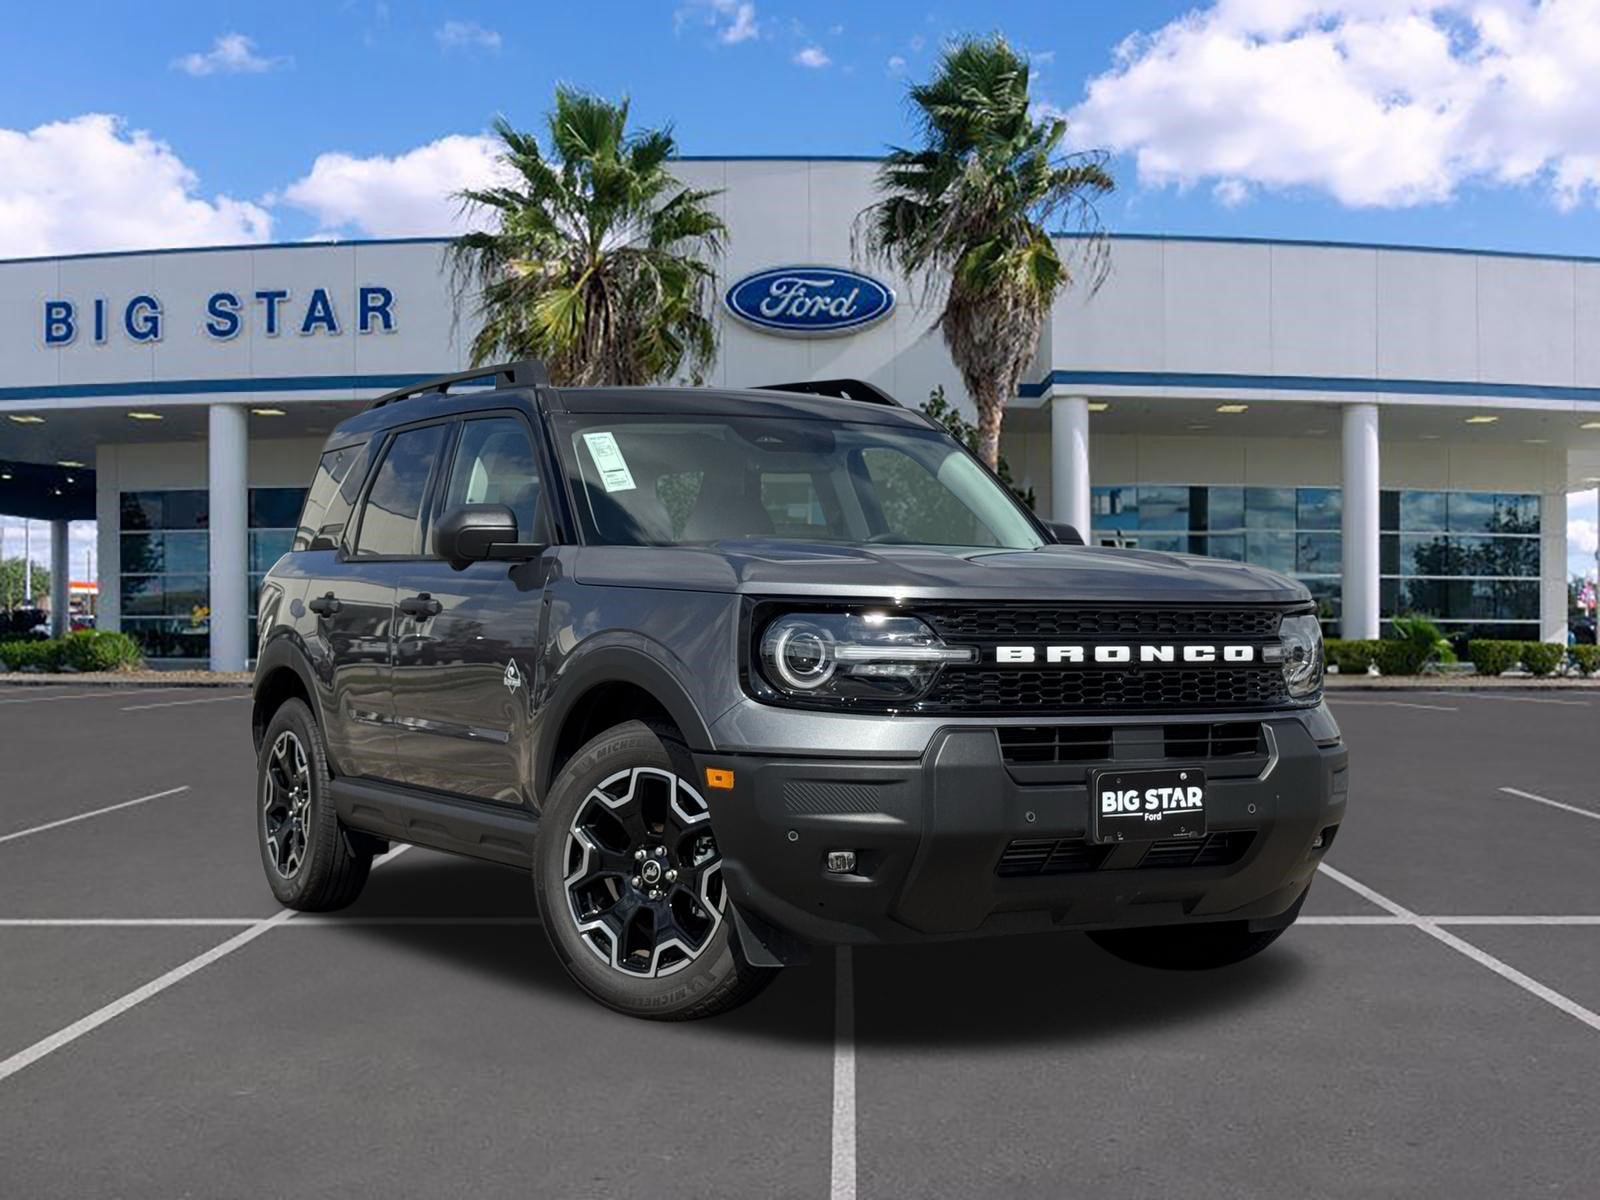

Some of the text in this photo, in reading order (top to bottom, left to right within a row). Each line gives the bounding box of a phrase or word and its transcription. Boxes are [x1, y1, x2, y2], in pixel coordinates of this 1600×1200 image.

[760, 277, 858, 317] Ford
[45, 287, 395, 343] BIG STAR
[996, 645, 1254, 662] BRONCO
[1102, 786, 1203, 812] BIG STAR
[1144, 812, 1162, 821] Ford
